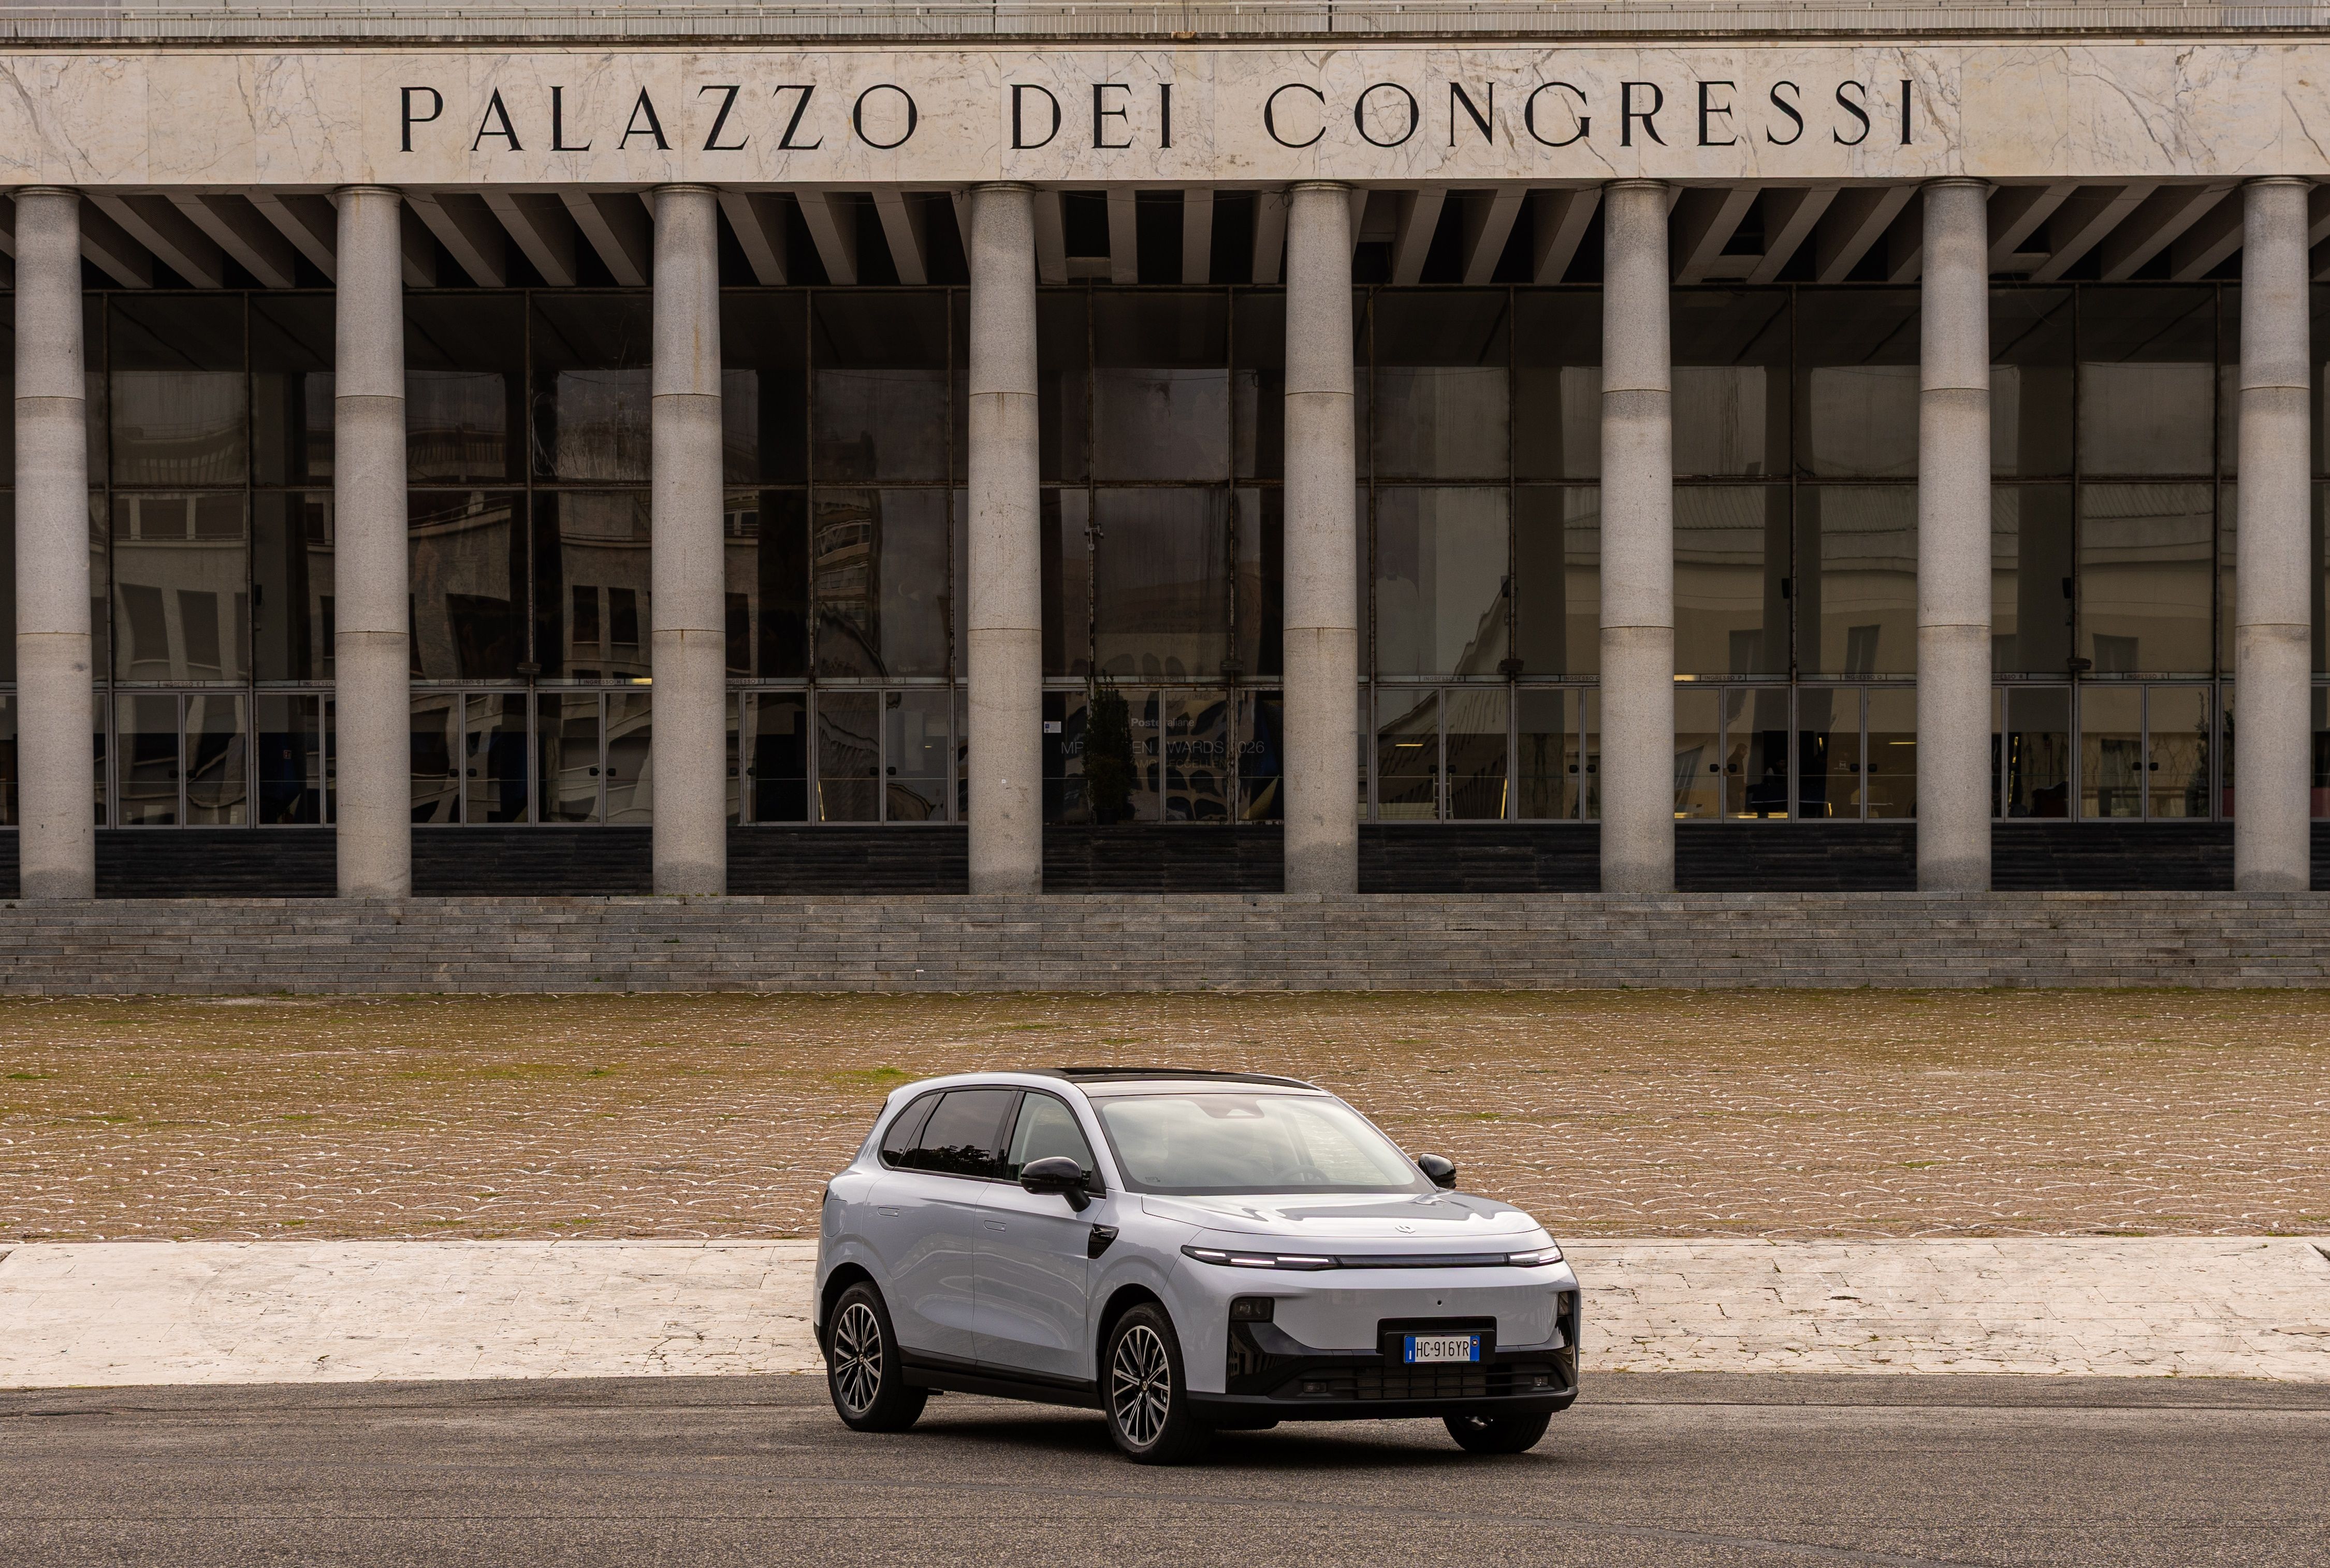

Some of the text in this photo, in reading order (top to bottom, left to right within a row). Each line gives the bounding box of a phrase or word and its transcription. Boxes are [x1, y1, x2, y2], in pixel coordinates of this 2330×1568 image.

[400, 80, 1912, 152] PALAZZO DEI CONGRESSI
[1157, 741, 1224, 754] WARDS
[1238, 741, 1265, 753] 026
